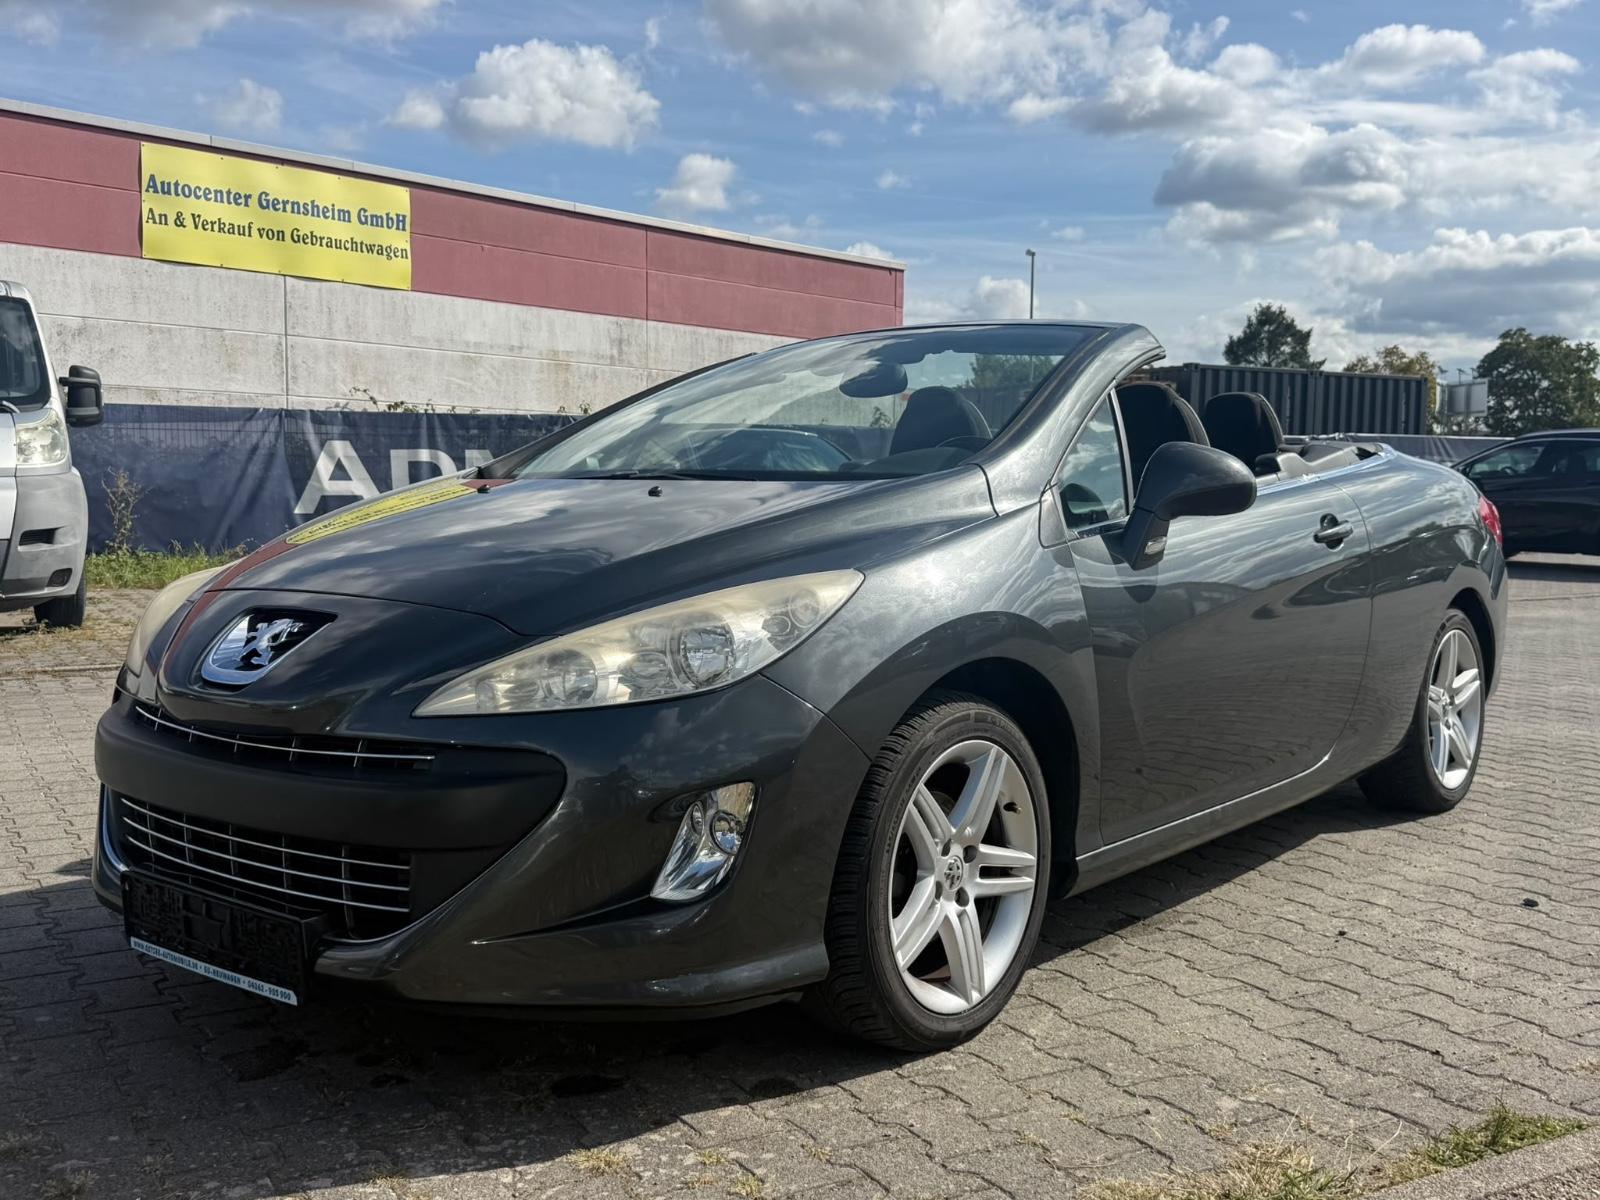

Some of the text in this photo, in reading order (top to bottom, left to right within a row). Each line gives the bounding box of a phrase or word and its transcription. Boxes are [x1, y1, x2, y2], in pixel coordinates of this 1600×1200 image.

[145, 174, 408, 232] Autocenter Gernsheim GmbH
[145, 207, 409, 261] An & Verkauf von Gebrauchtwagen
